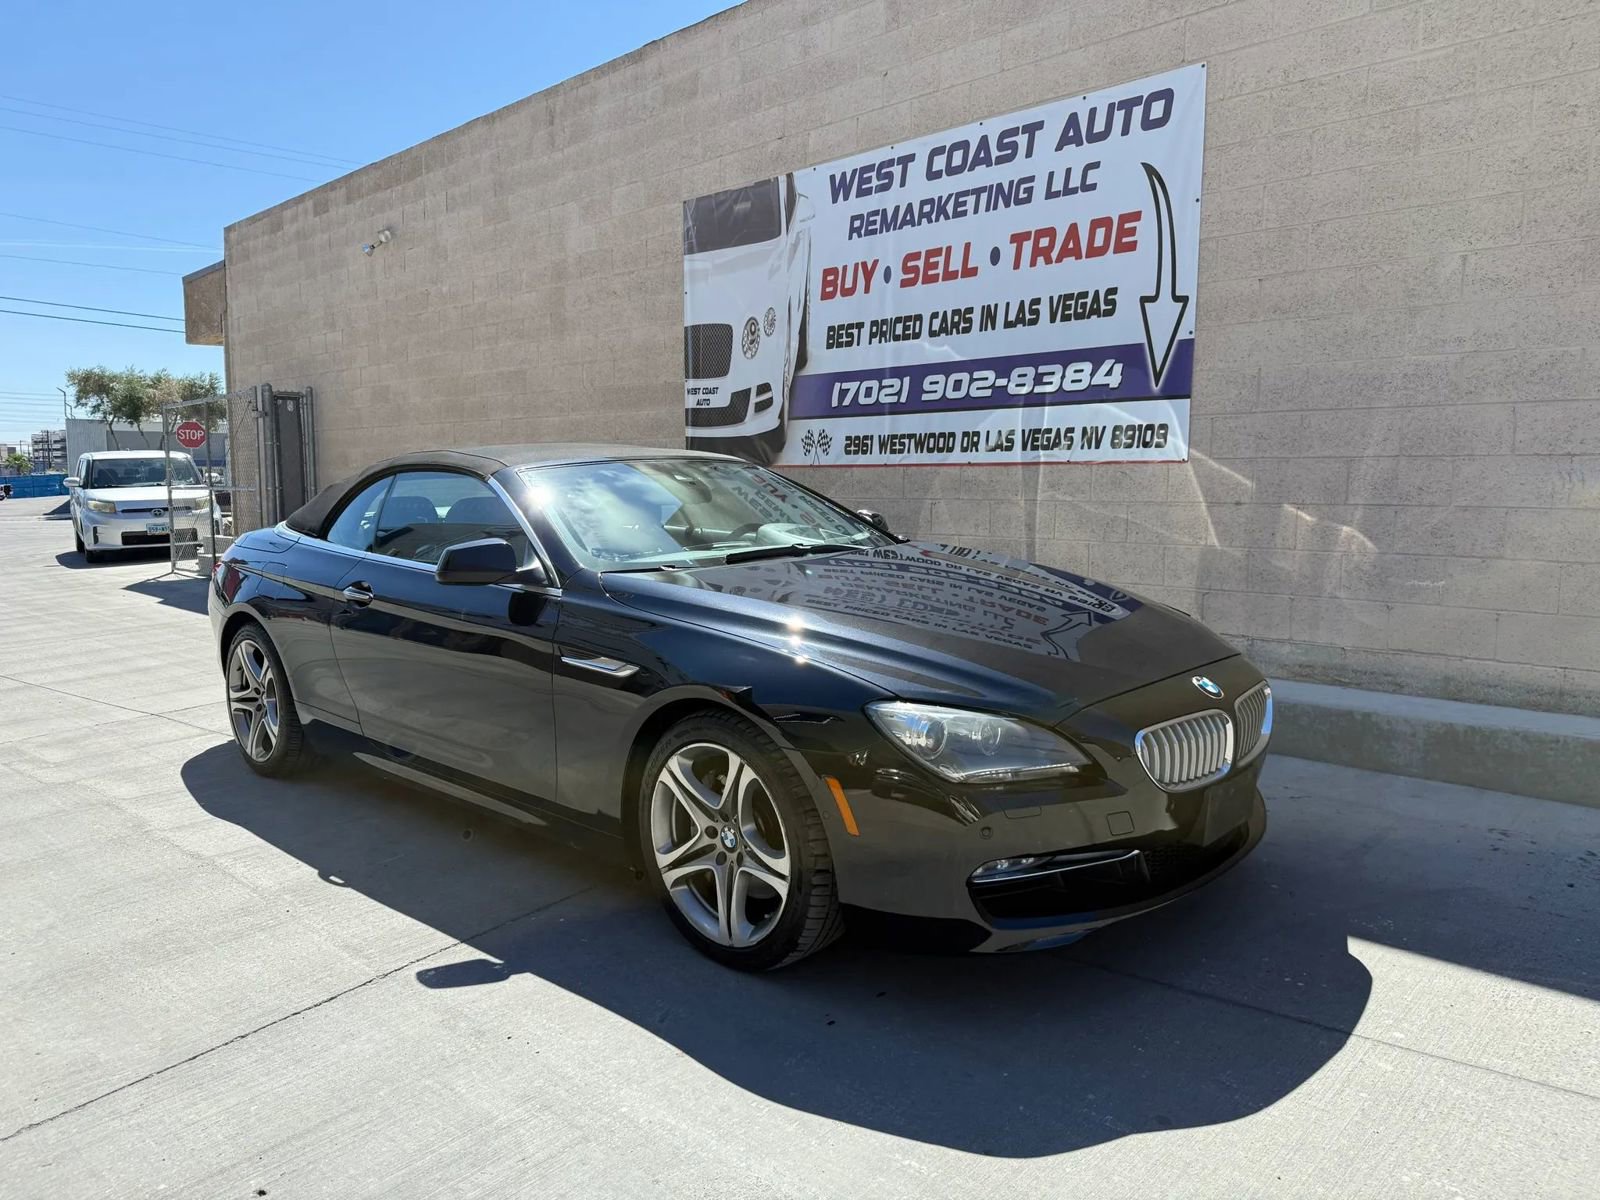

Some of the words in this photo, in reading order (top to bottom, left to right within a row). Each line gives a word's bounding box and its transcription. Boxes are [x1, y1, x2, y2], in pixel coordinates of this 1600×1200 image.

[829, 153, 916, 204] WEST
[925, 120, 1045, 181] COAST
[1054, 88, 1174, 152] AUTO
[848, 175, 1036, 240] REMARKETING
[1044, 161, 1101, 200] LLC
[820, 259, 879, 301] BUY
[900, 242, 979, 288] SELL
[1009, 210, 1143, 271] TRADE
[826, 321, 865, 349] BEST
[868, 313, 923, 345] PRICED
[928, 306, 974, 338] CARS
[979, 303, 999, 332] IN
[1003, 297, 1042, 329] LAS
[1048, 286, 1118, 324] VEGAS
[686, 387, 701, 396] WEST
[702, 386, 719, 395] COAST
[696, 398, 711, 406] AUTO
[831, 376, 910, 408] (702)
[921, 358, 1124, 401] 902-8384
[178, 429, 205, 441] STOP
[844, 434, 874, 455] 2961
[878, 431, 956, 455] WESTWOOD
[960, 430, 981, 453] DR
[985, 428, 1016, 452] LAS
[1021, 426, 1076, 451] VEGAS
[1080, 425, 1107, 450] NV
[1110, 423, 1169, 450] 89109
